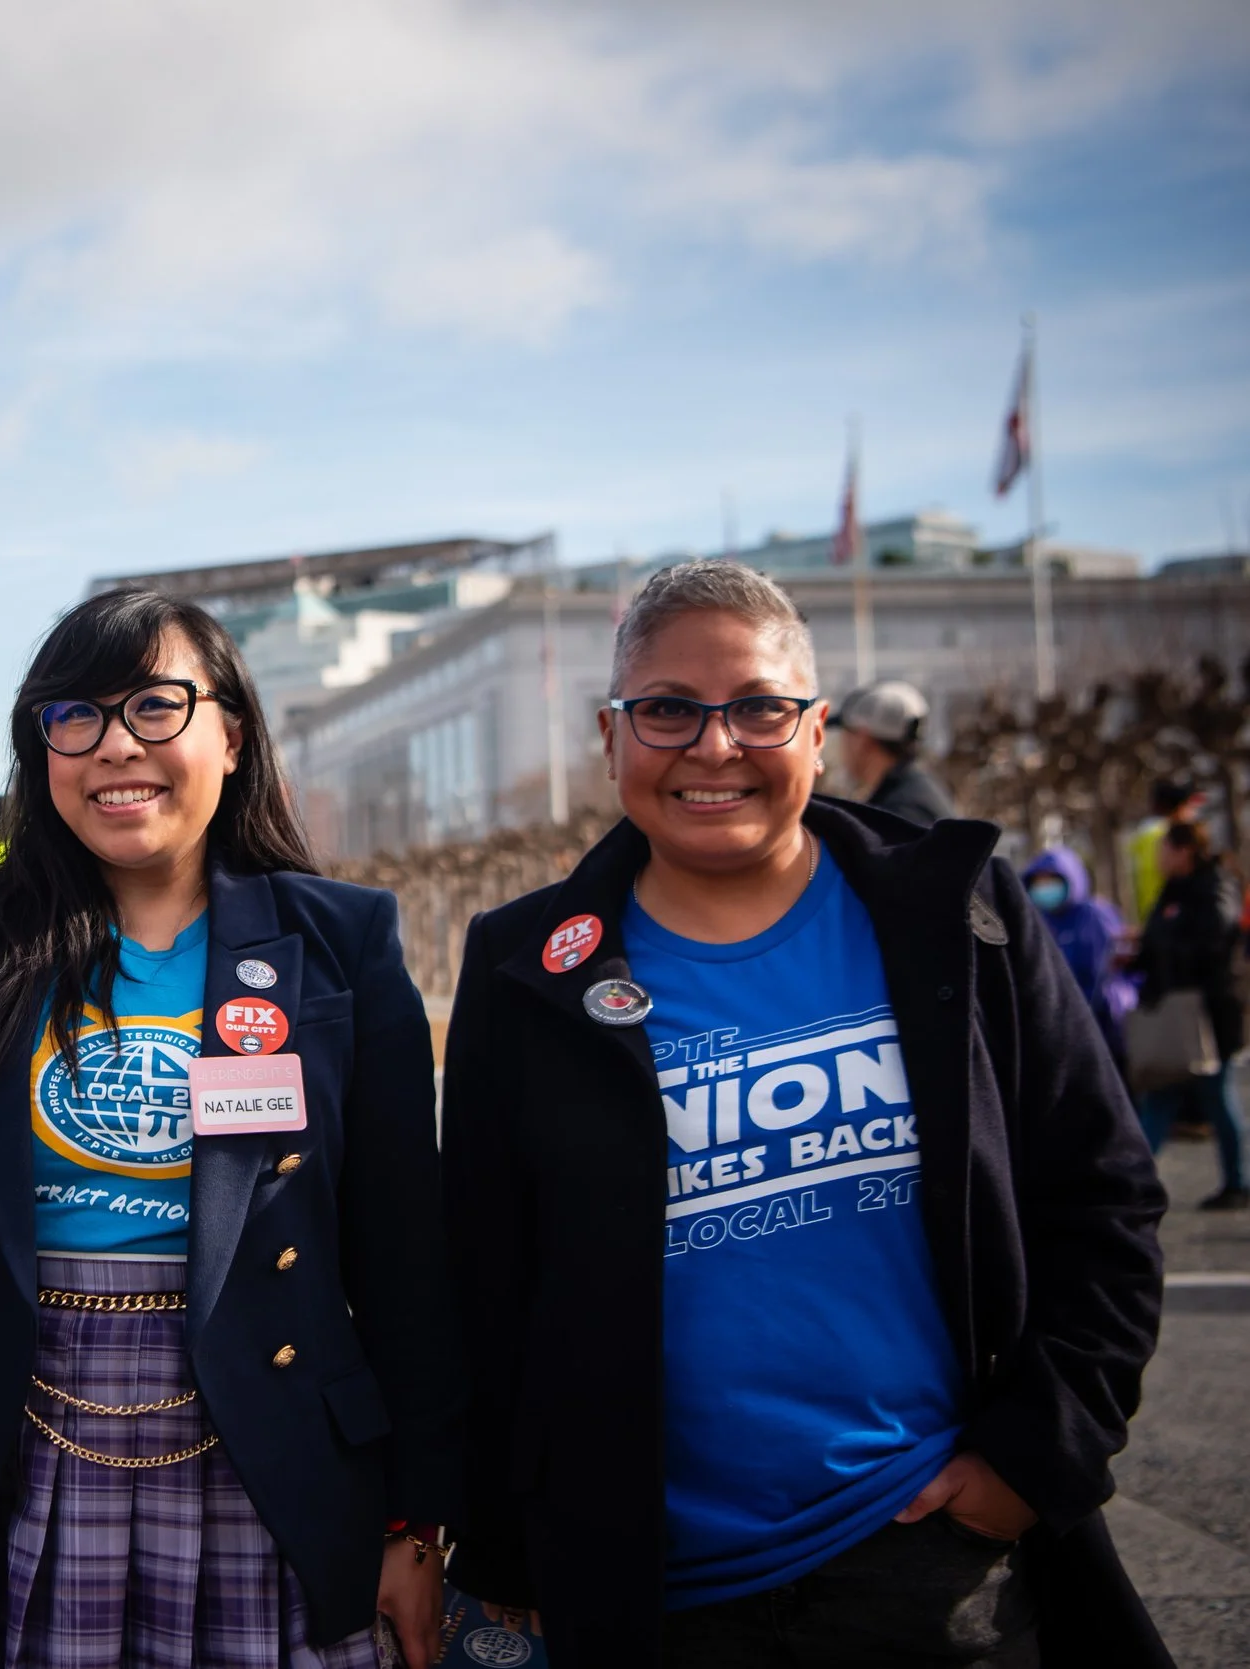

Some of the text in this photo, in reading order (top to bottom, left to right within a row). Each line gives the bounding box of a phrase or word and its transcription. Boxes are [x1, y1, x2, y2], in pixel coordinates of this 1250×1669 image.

[550, 935, 593, 958] OUR CITY
[551, 918, 593, 950] FIX
[225, 1024, 277, 1034] OUR CITY
[226, 1005, 277, 1025] FIX
[650, 1026, 739, 1063] PTE
[48, 1039, 105, 1115] PROFESSNAL
[126, 1032, 201, 1058] TECHNICAL
[692, 1055, 744, 1080] THE
[71, 1079, 163, 1105] LOCAL
[204, 1097, 293, 1113] NATALIE GEE
[660, 1043, 911, 1153] NION
[74, 1132, 120, 1159] IFPTE
[667, 1114, 920, 1197] IKES BACK
[35, 1184, 190, 1222] TRACT ACTIO
[663, 1190, 833, 1258] LOCAL
